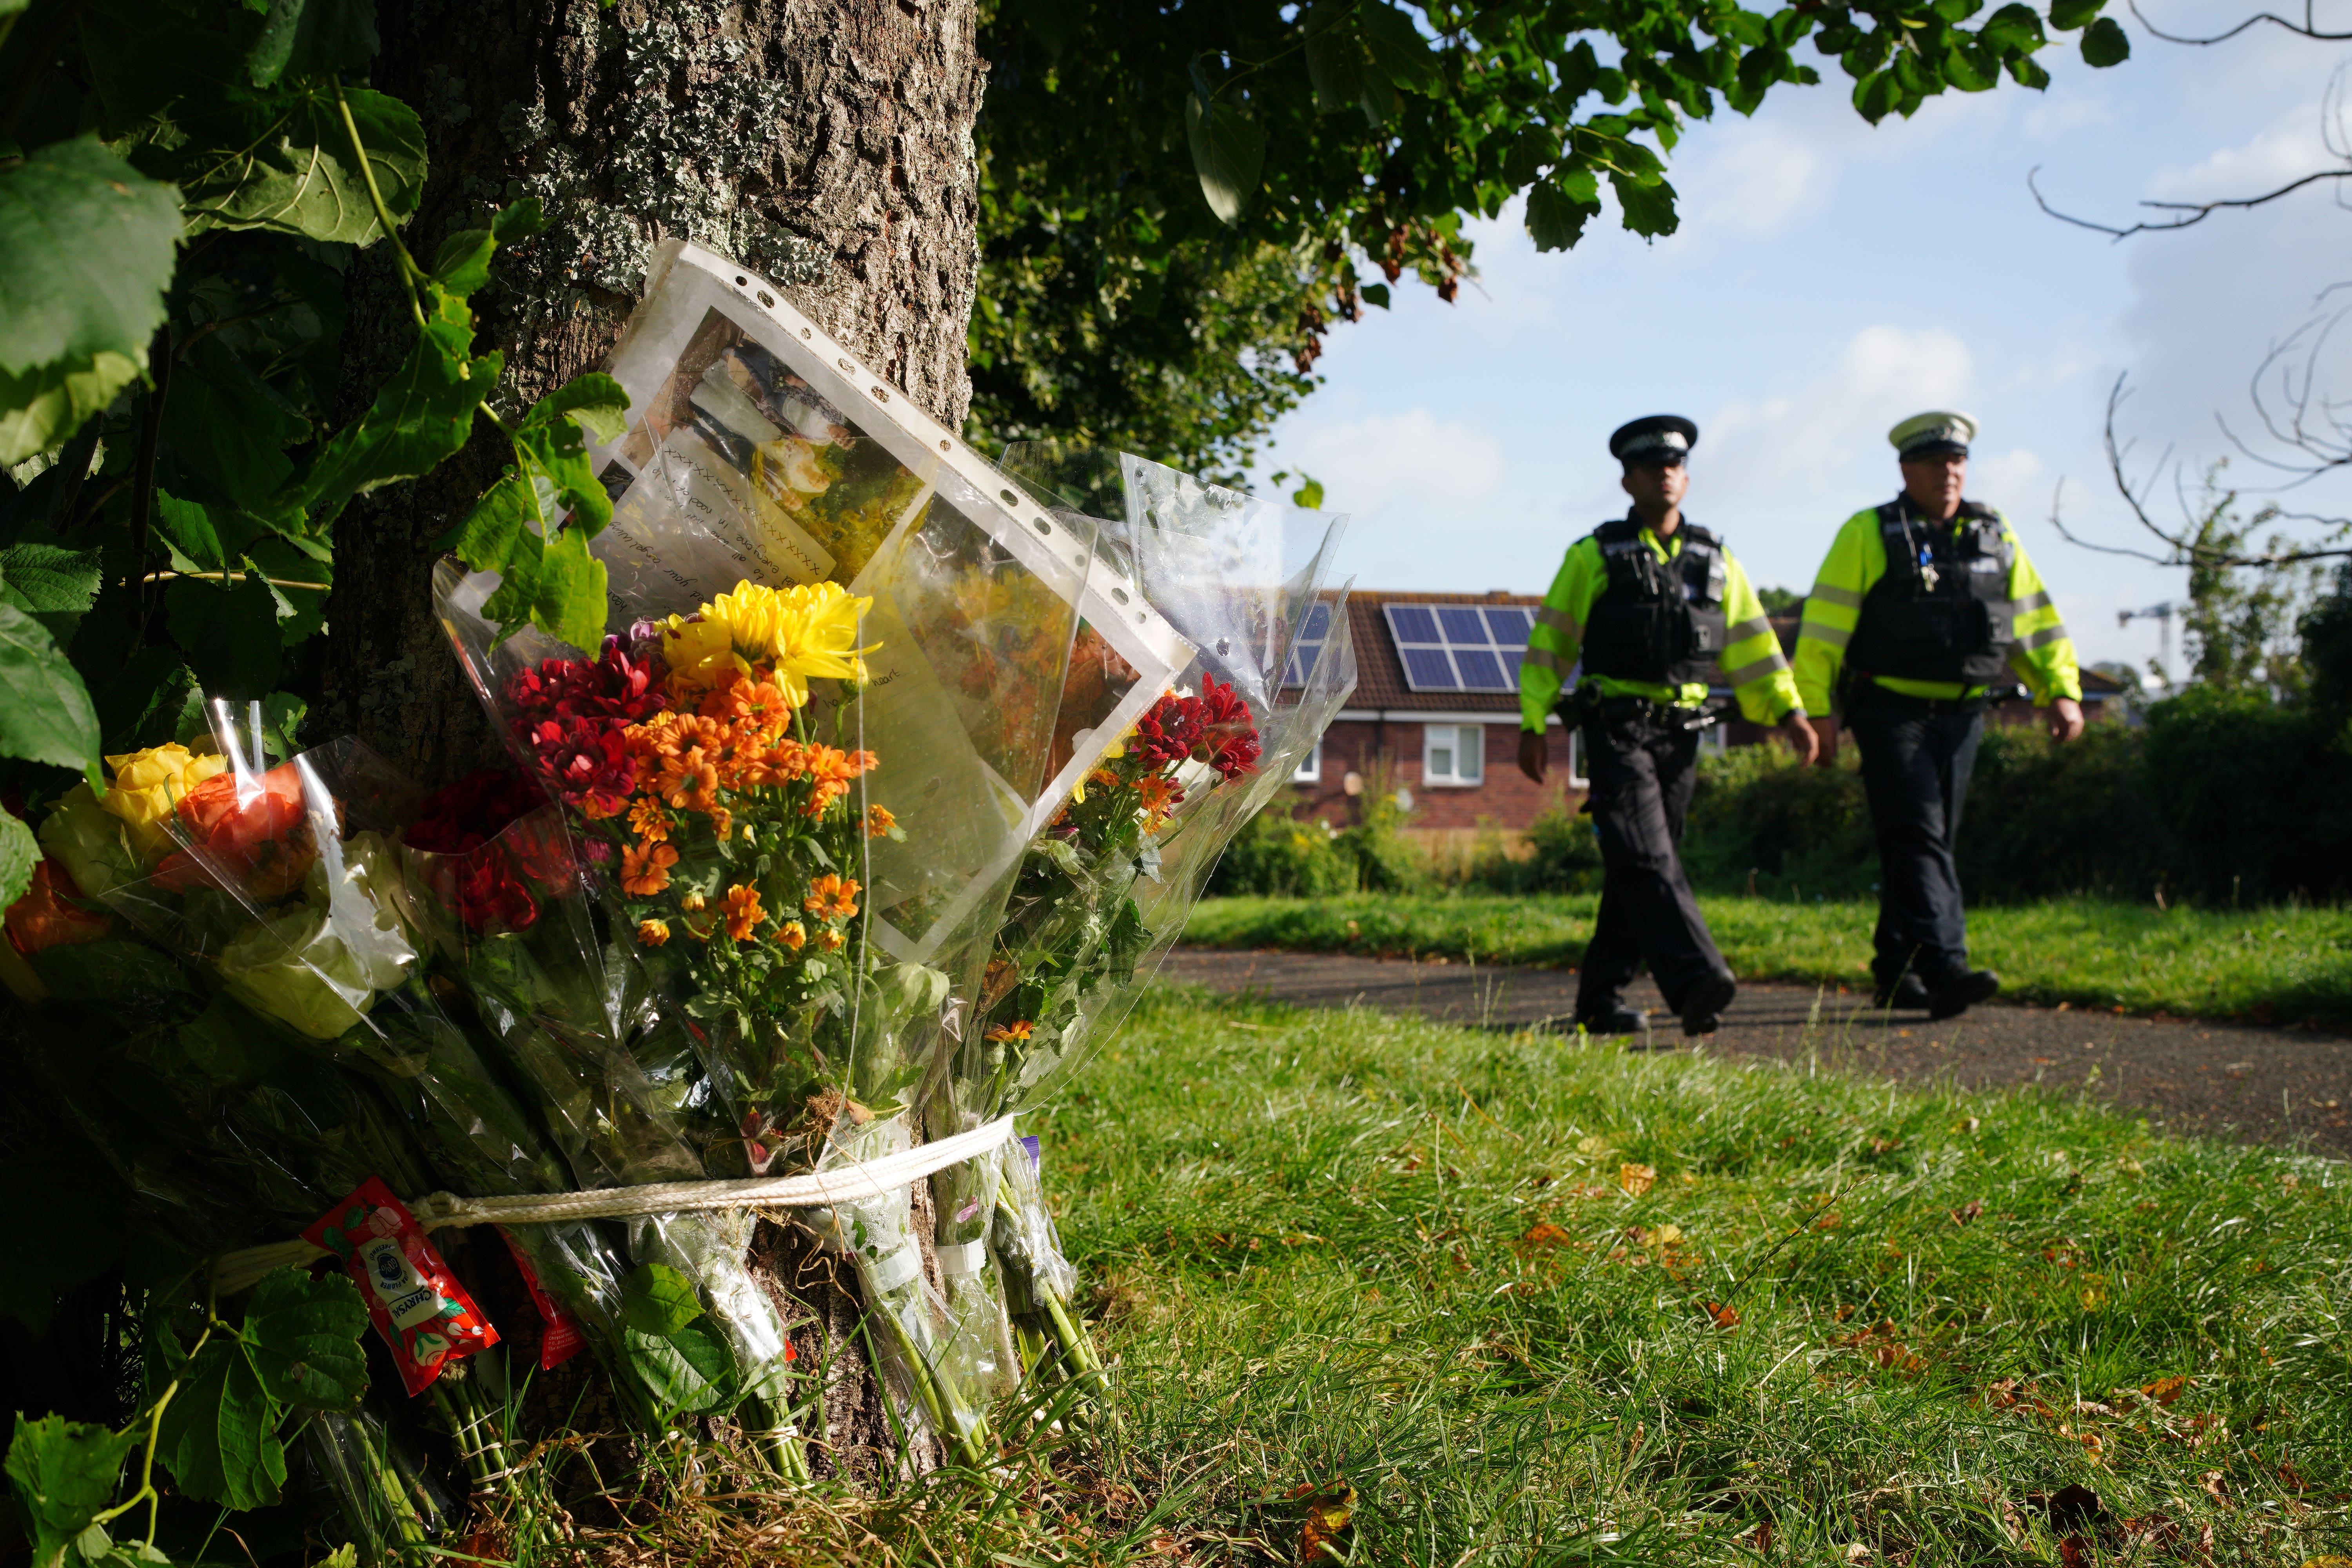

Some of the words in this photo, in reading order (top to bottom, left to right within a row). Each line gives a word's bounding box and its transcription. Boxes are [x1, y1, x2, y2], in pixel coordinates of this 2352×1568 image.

[711, 531, 730, 547] who
[630, 544, 661, 563] angel
[732, 553, 746, 561] all
[663, 570, 698, 587] your
[754, 569, 764, 581] to
[606, 590, 627, 612] hear
[871, 669, 900, 686] heart
[381, 1258, 397, 1274] 60%
[392, 1290, 432, 1318] CHRYSAL
